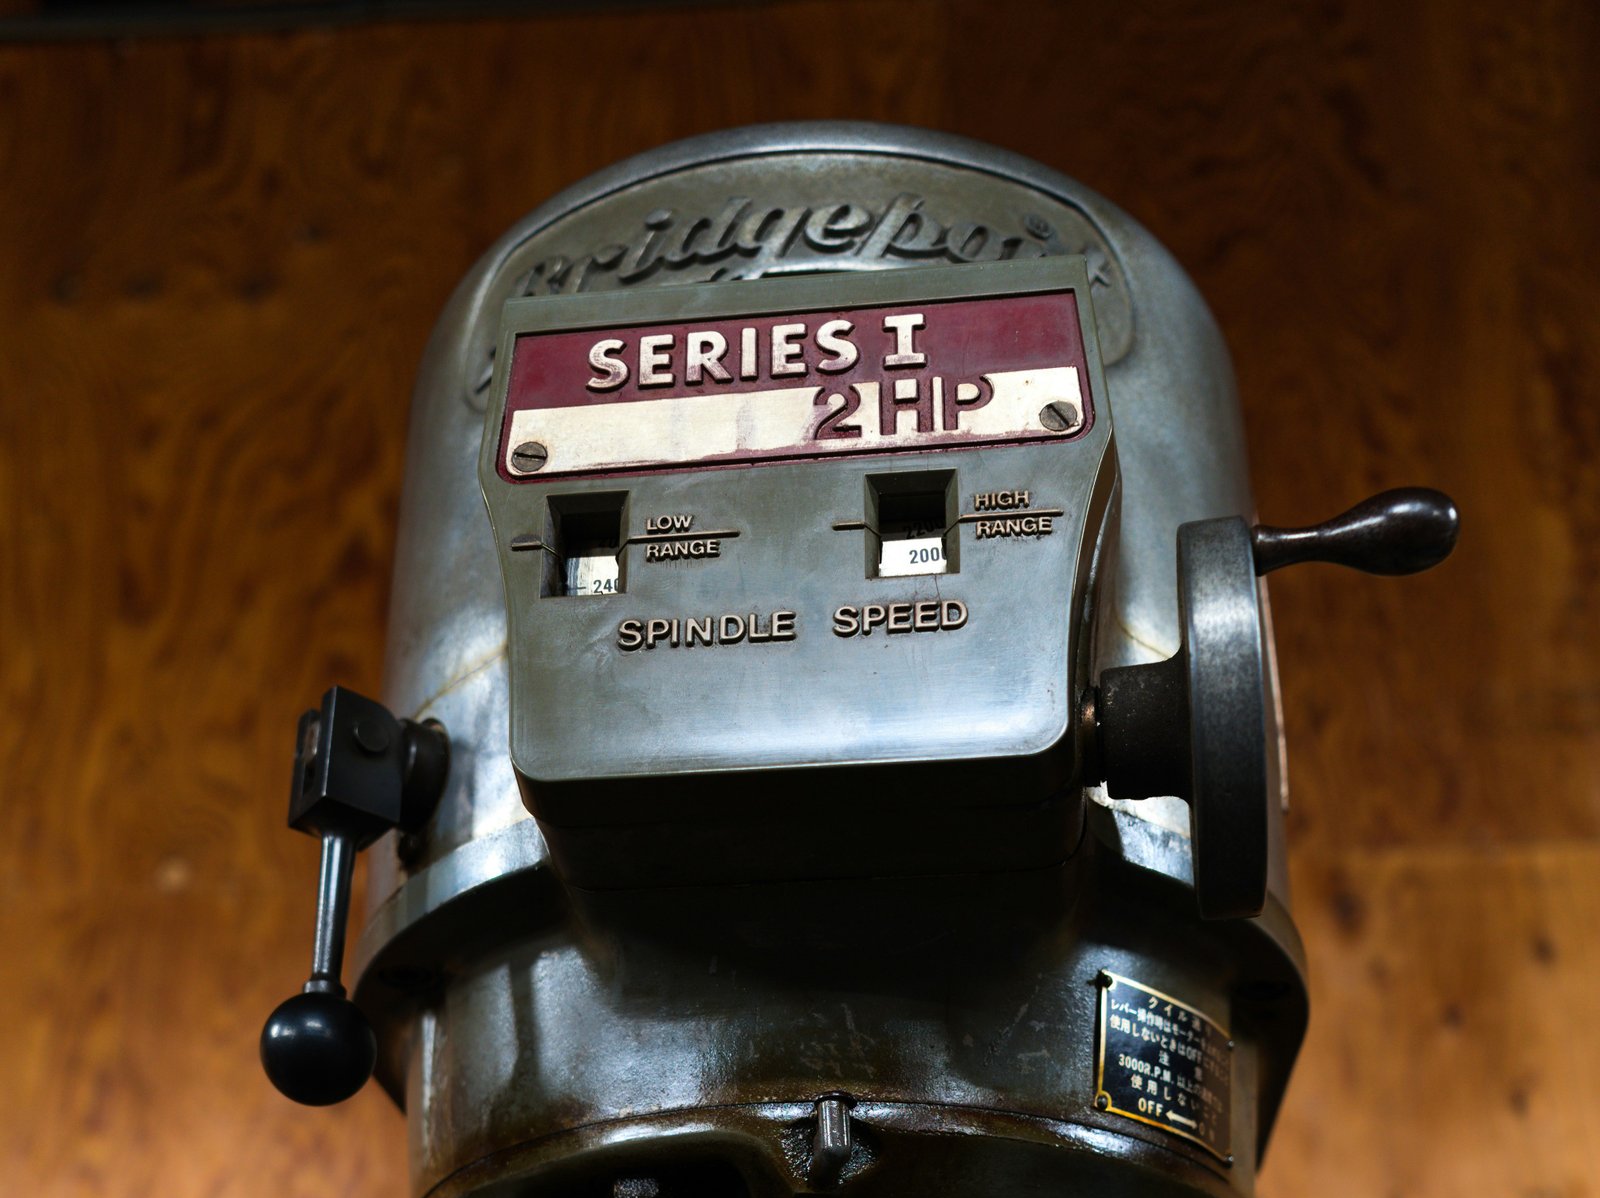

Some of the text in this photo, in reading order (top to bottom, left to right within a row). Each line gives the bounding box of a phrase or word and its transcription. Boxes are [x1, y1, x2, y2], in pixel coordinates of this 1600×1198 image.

[585, 312, 927, 393] SERIES I
[974, 490, 1029, 511] HIGH
[646, 515, 693, 534] LOW
[976, 516, 1052, 539] RANGE
[646, 540, 721, 561] RANGE
[617, 600, 969, 651] SPINDLE SPEED
[1138, 1097, 1163, 1118] OFF
